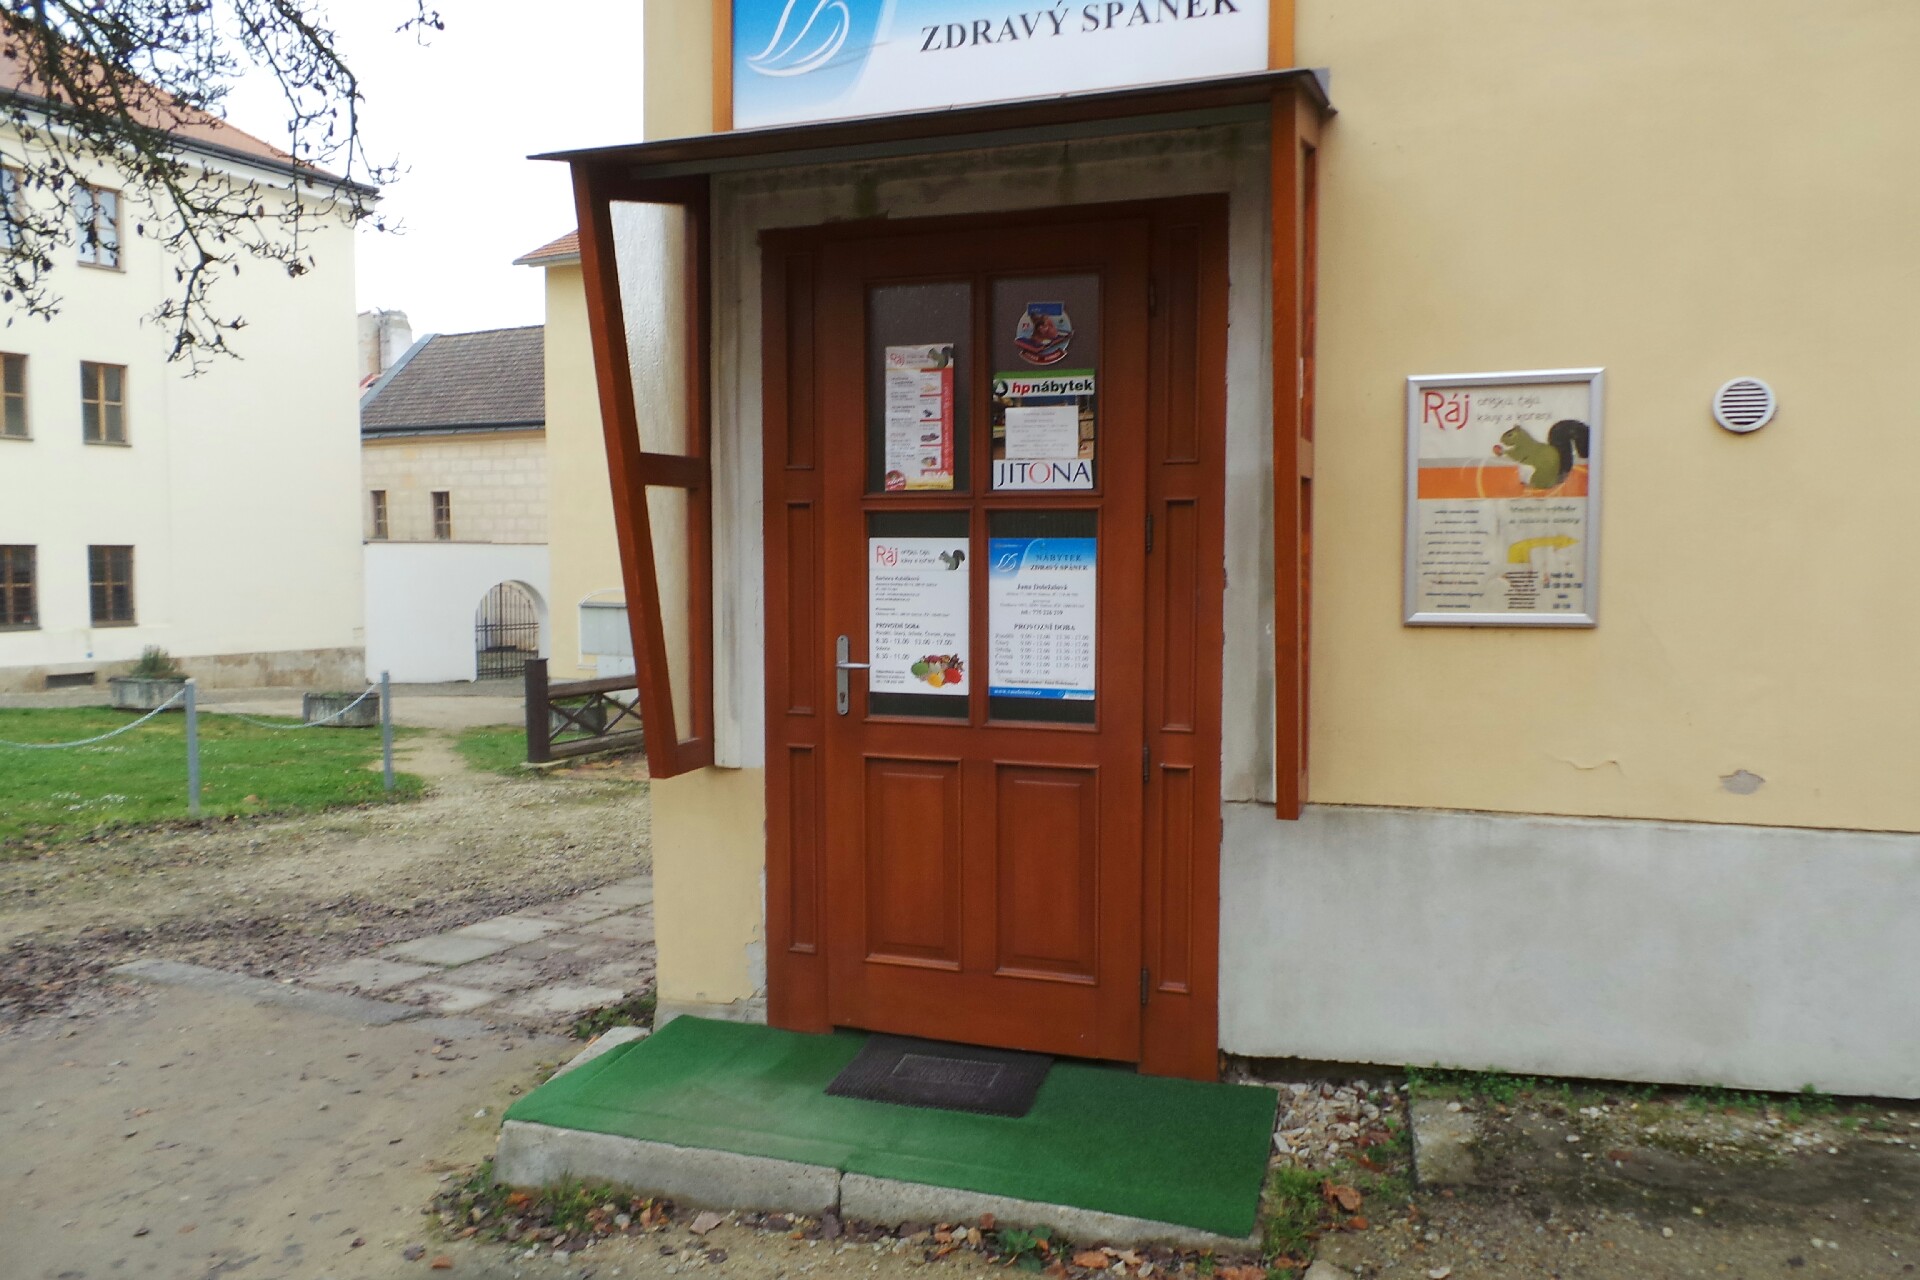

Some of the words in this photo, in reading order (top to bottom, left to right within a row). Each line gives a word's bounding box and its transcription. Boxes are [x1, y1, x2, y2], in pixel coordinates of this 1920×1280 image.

[920, 1, 1069, 53] ZDRAVÝ
[1423, 390, 1471, 431] Ráj
[998, 461, 1091, 487] JITONA
[876, 545, 898, 566] Ráj
